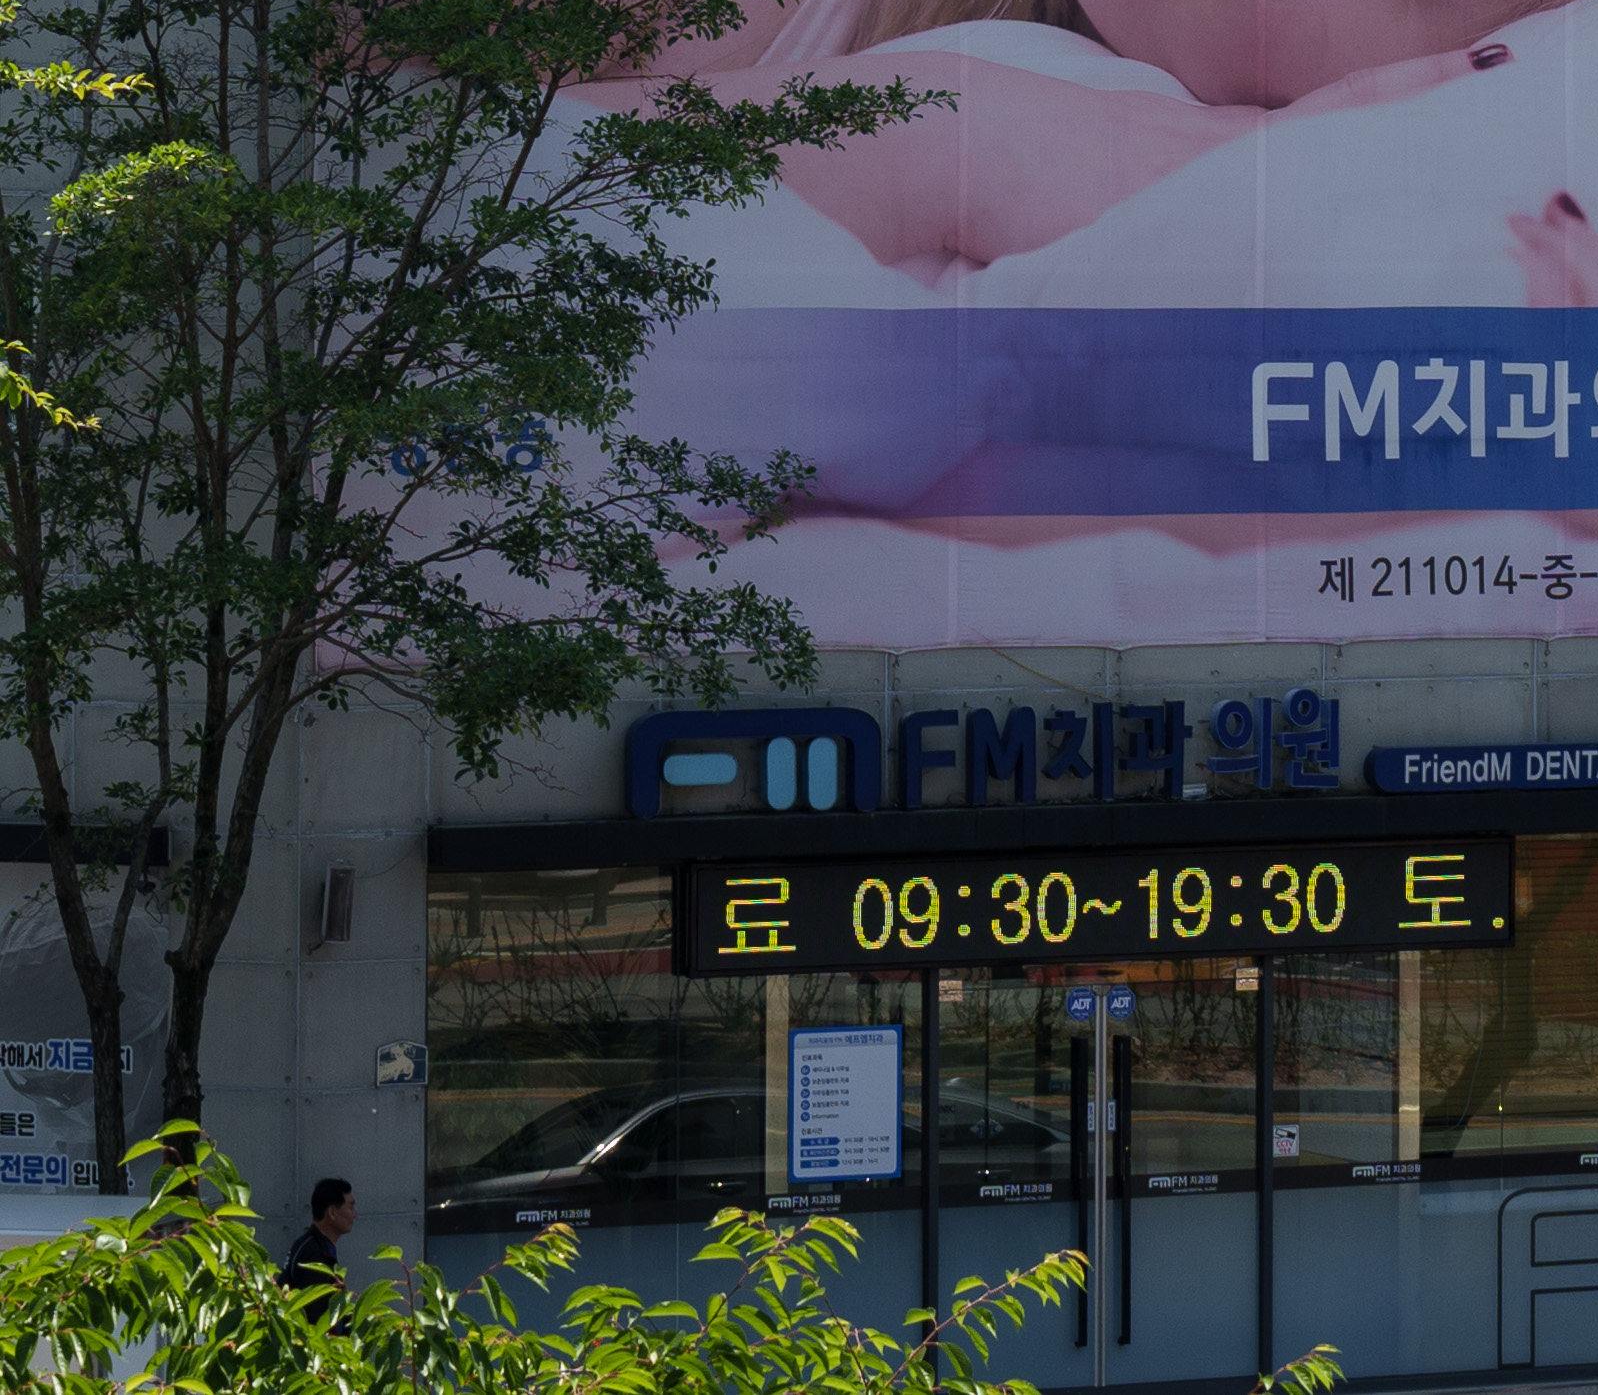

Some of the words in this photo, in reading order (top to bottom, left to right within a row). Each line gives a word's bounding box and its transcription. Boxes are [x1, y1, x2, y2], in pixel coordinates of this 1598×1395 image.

[1318, 555, 1356, 603] 제
[1404, 751, 1512, 786] FriendM
[718, 877, 797, 955] 료
[853, 862, 1346, 951] 09:30~19:30
[1071, 998, 1092, 1011] ADT
[1110, 996, 1131, 1009] ADT
[1276, 1140, 1293, 1150] CCTV
[0, 1155, 68, 1186] 전문의
